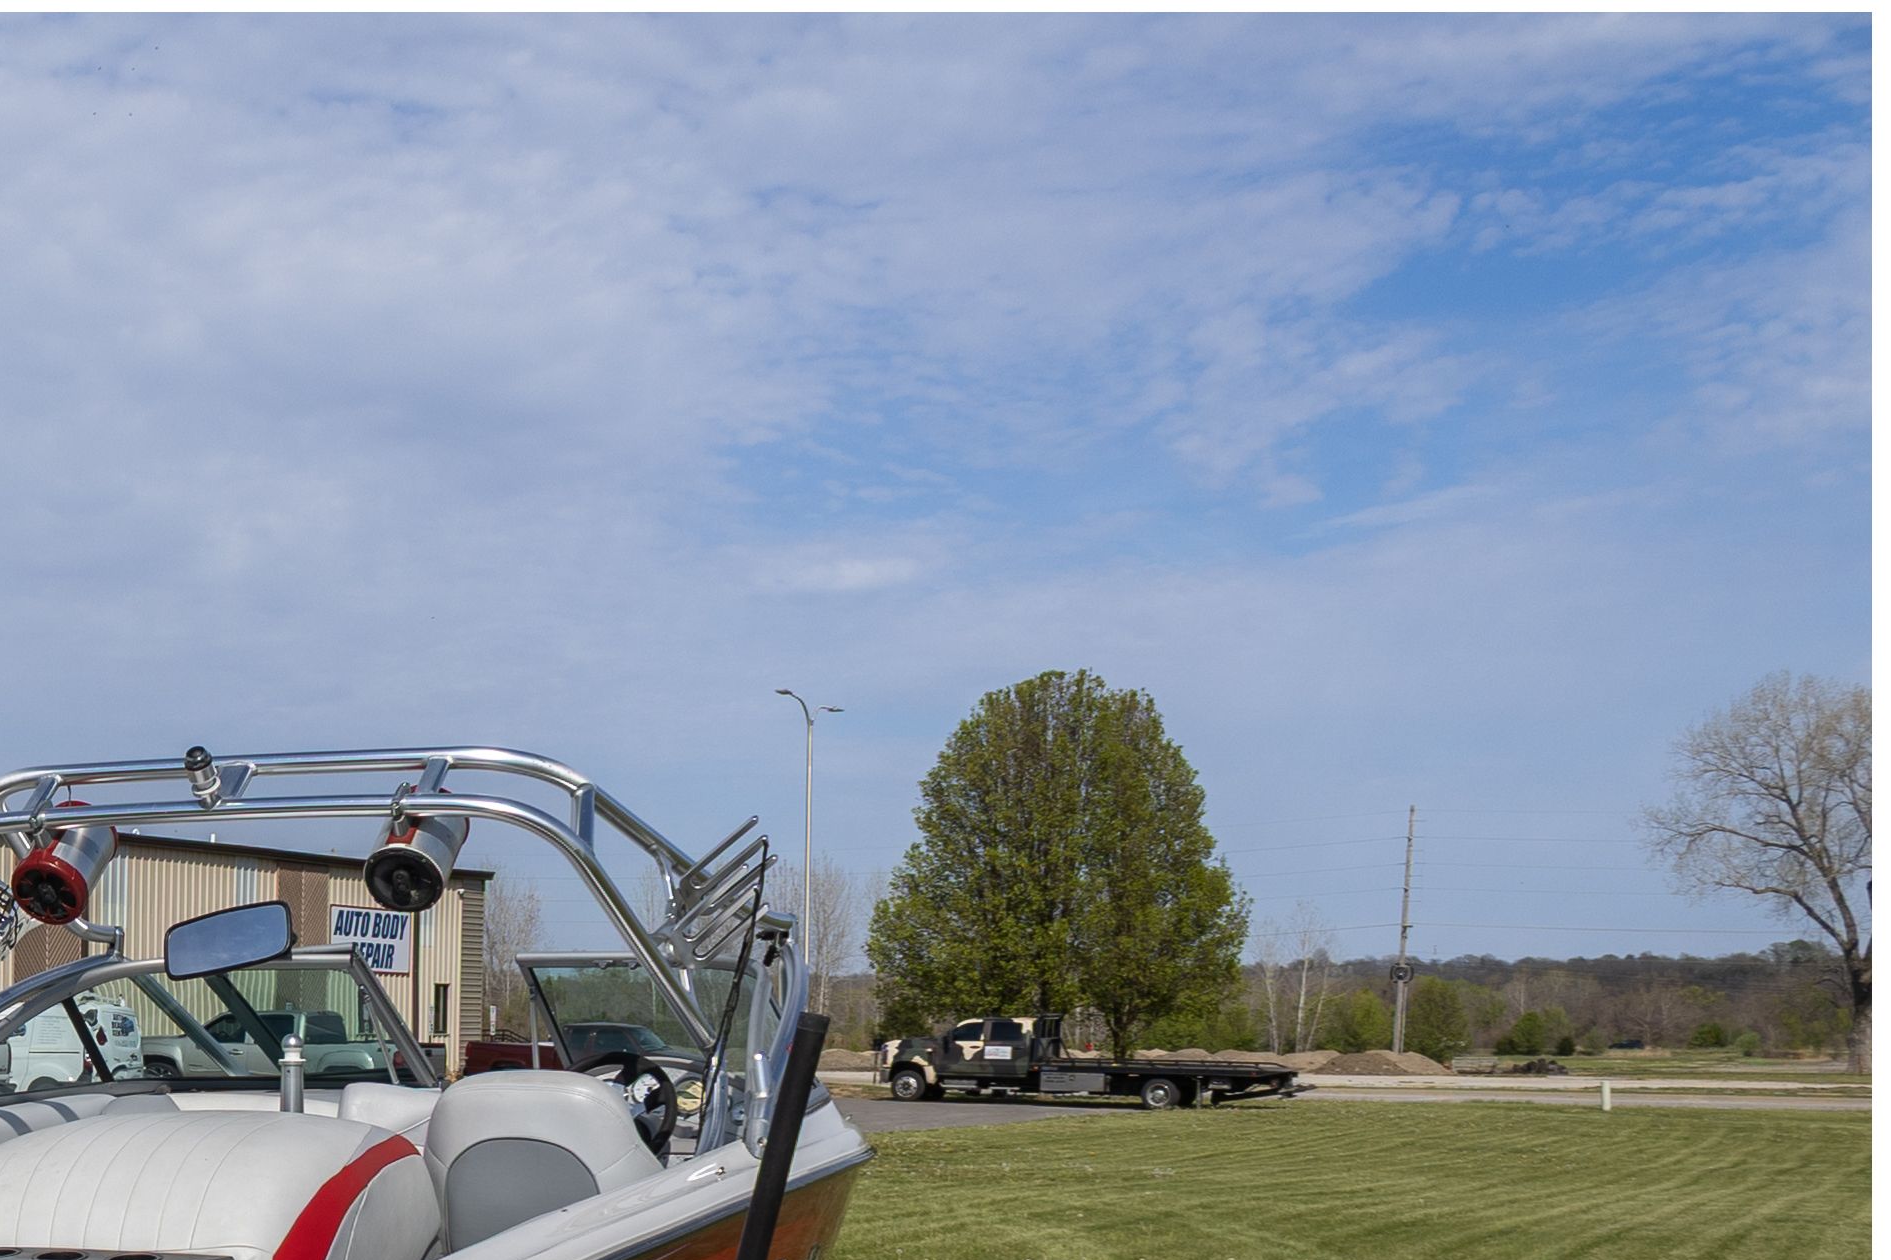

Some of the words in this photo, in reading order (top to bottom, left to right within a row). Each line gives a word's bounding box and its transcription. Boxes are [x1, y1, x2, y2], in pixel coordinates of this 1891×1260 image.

[333, 909, 371, 937] AUTO
[372, 912, 409, 940] BODY
[353, 942, 395, 969] EPAIR
